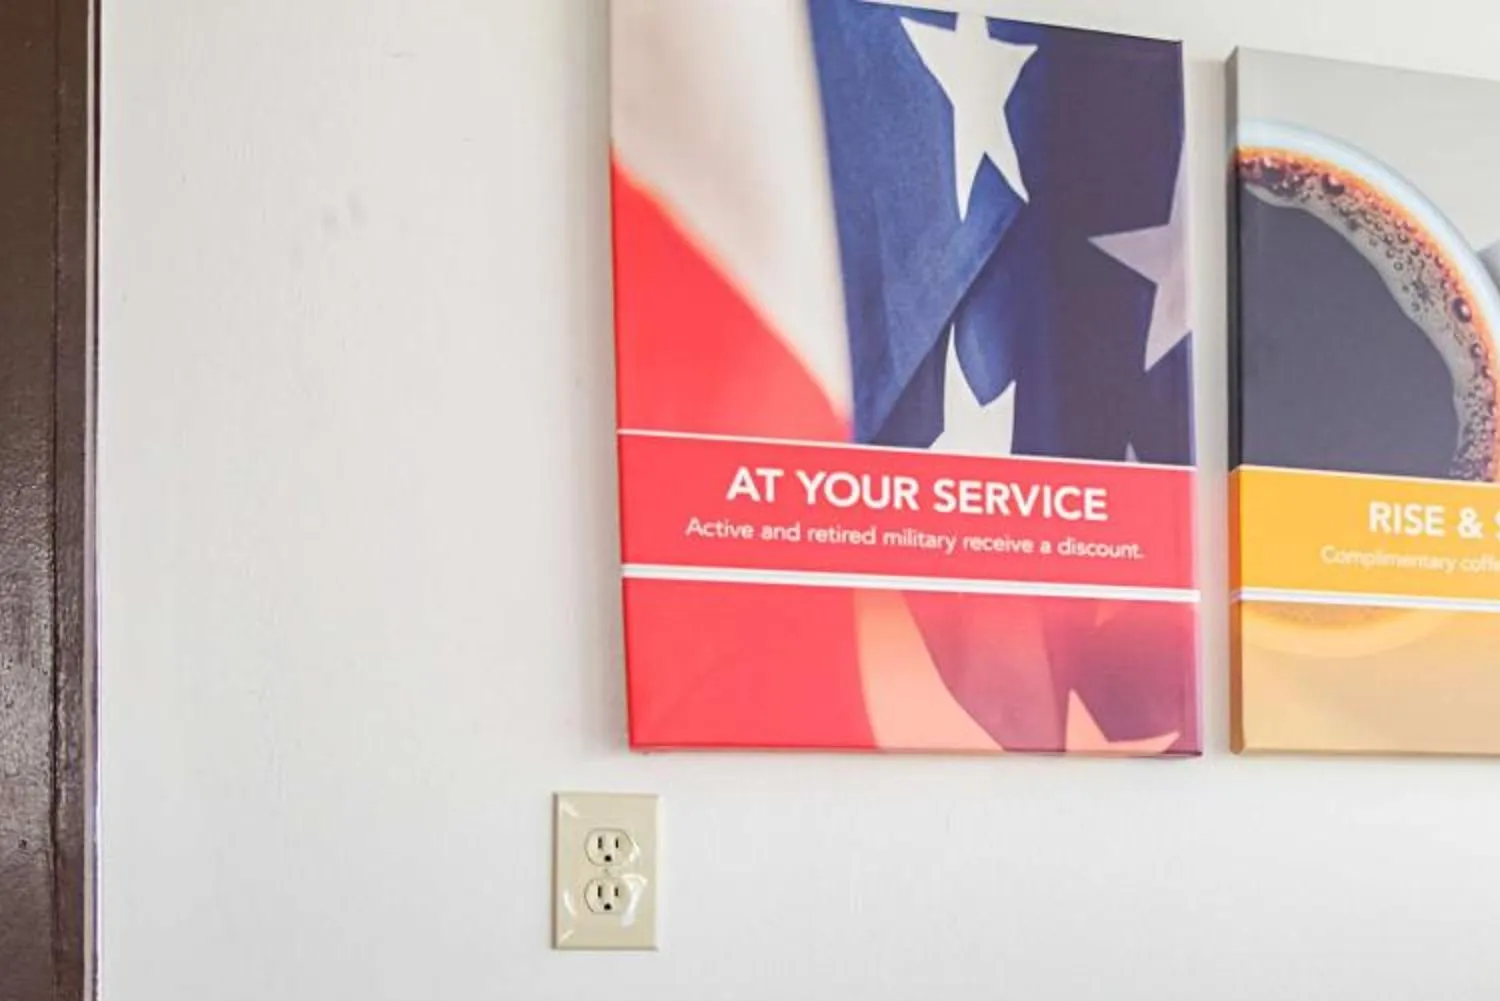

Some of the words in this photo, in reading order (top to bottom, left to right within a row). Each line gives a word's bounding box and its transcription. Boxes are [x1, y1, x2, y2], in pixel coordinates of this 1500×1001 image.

[726, 465, 784, 503] AT
[795, 469, 920, 511] YOUR
[933, 477, 1109, 522] SERVICE
[685, 516, 754, 540] Active
[761, 521, 801, 542] and
[807, 524, 876, 546] retired
[882, 527, 957, 555] military
[963, 533, 1033, 554] receive
[1039, 541, 1051, 555] a
[1056, 536, 1144, 560] discount.
[1368, 500, 1446, 538] RISE
[1456, 506, 1485, 540] &
[1320, 544, 1456, 575] Complimentary
